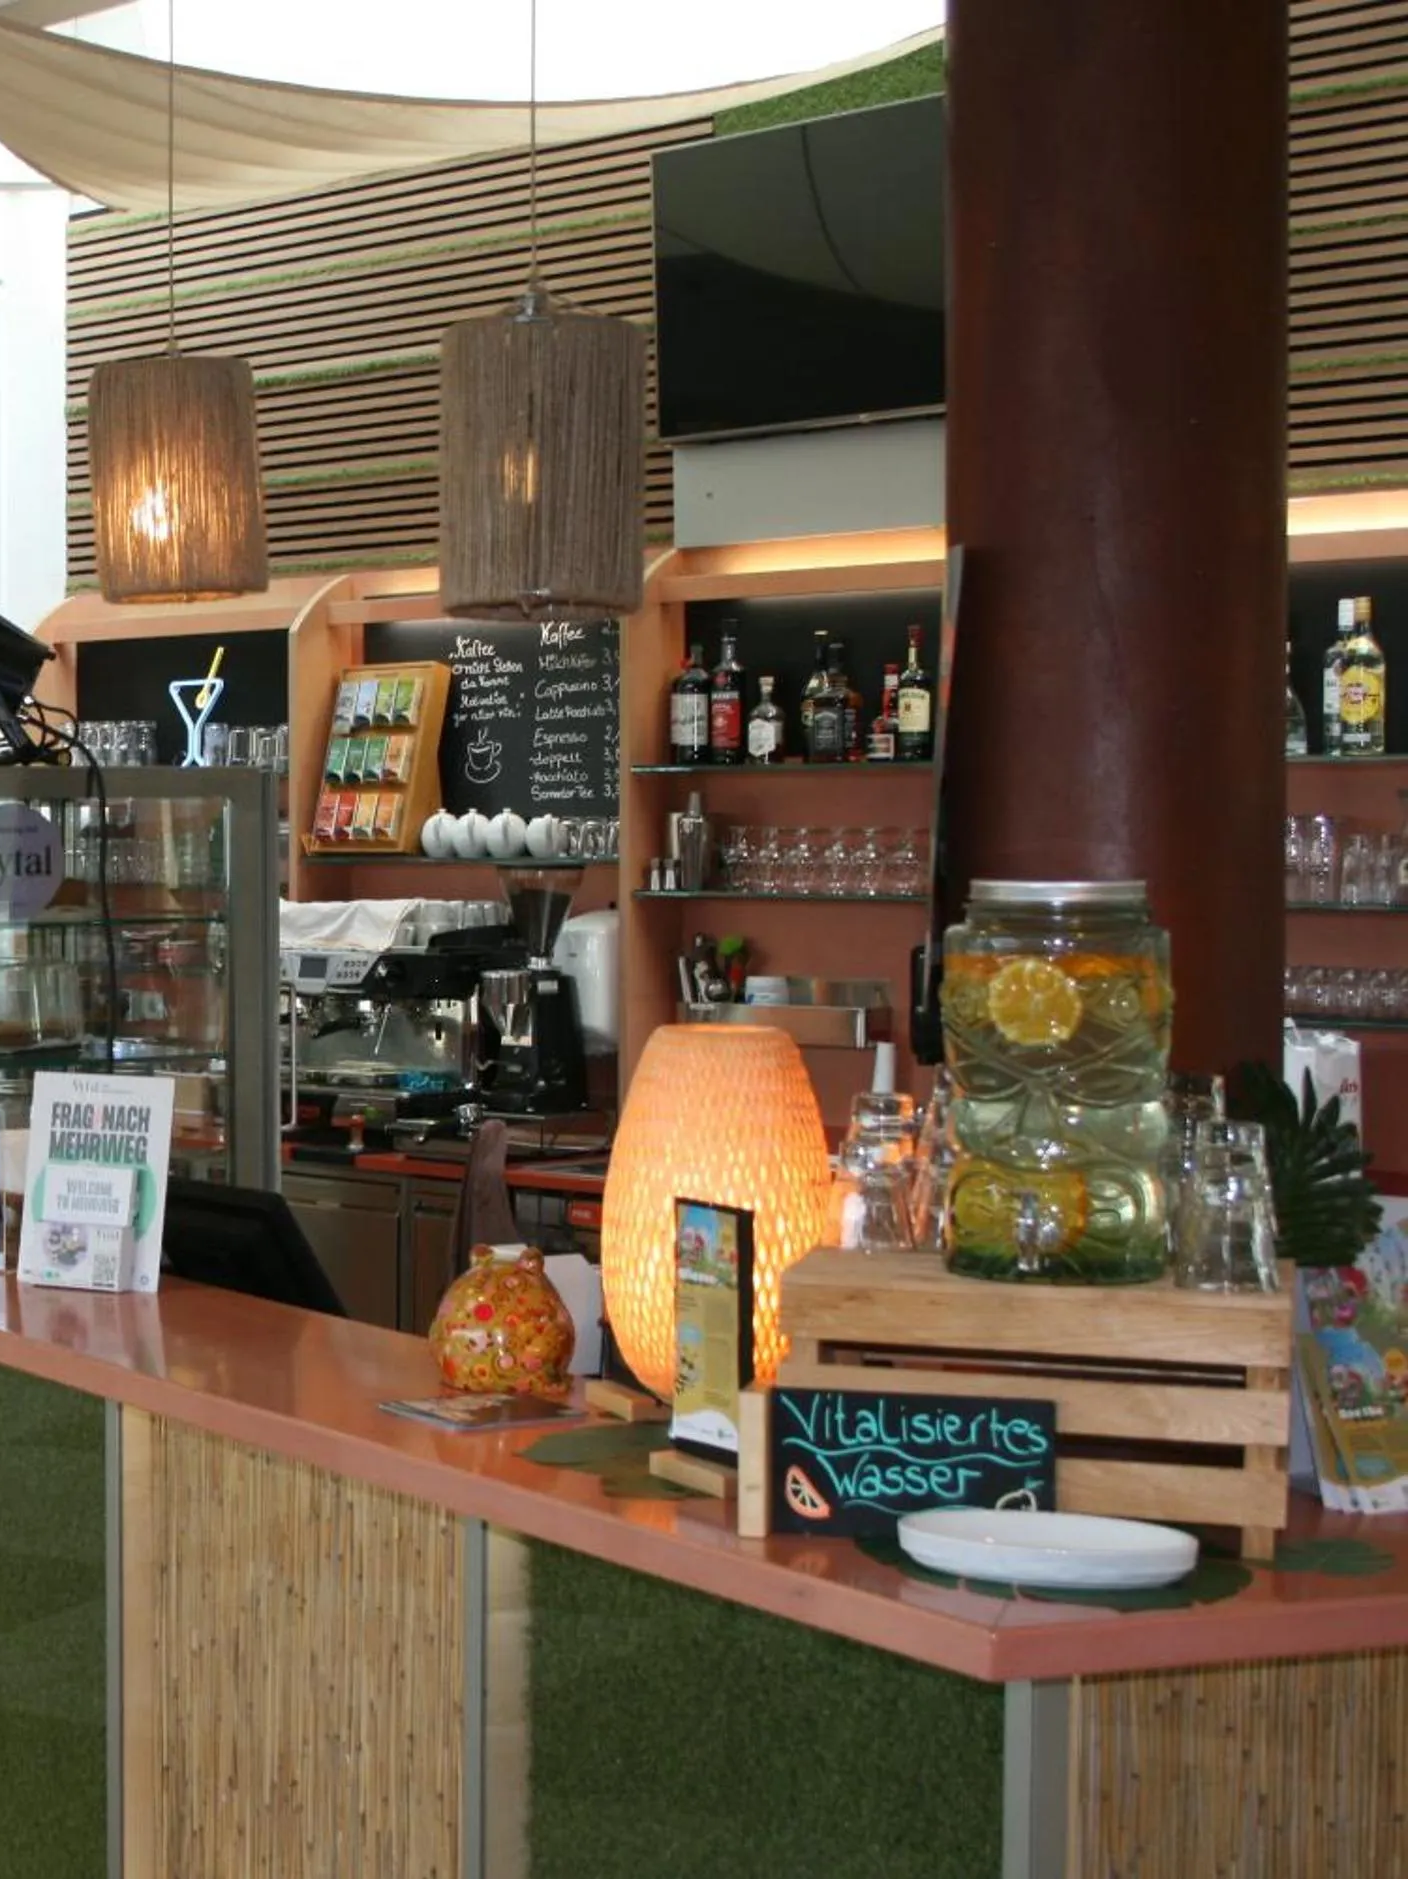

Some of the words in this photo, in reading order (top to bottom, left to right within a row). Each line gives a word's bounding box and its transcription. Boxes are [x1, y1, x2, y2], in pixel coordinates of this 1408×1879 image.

[540, 621, 587, 651] Kaffee
[533, 727, 589, 750] Espresso
[51, 1102, 95, 1130] FRAG
[101, 1104, 151, 1133] NACH
[48, 1131, 149, 1165] MEHRWEG
[779, 1392, 1049, 1455] Vitalisiertes
[815, 1453, 983, 1498] Wasser
